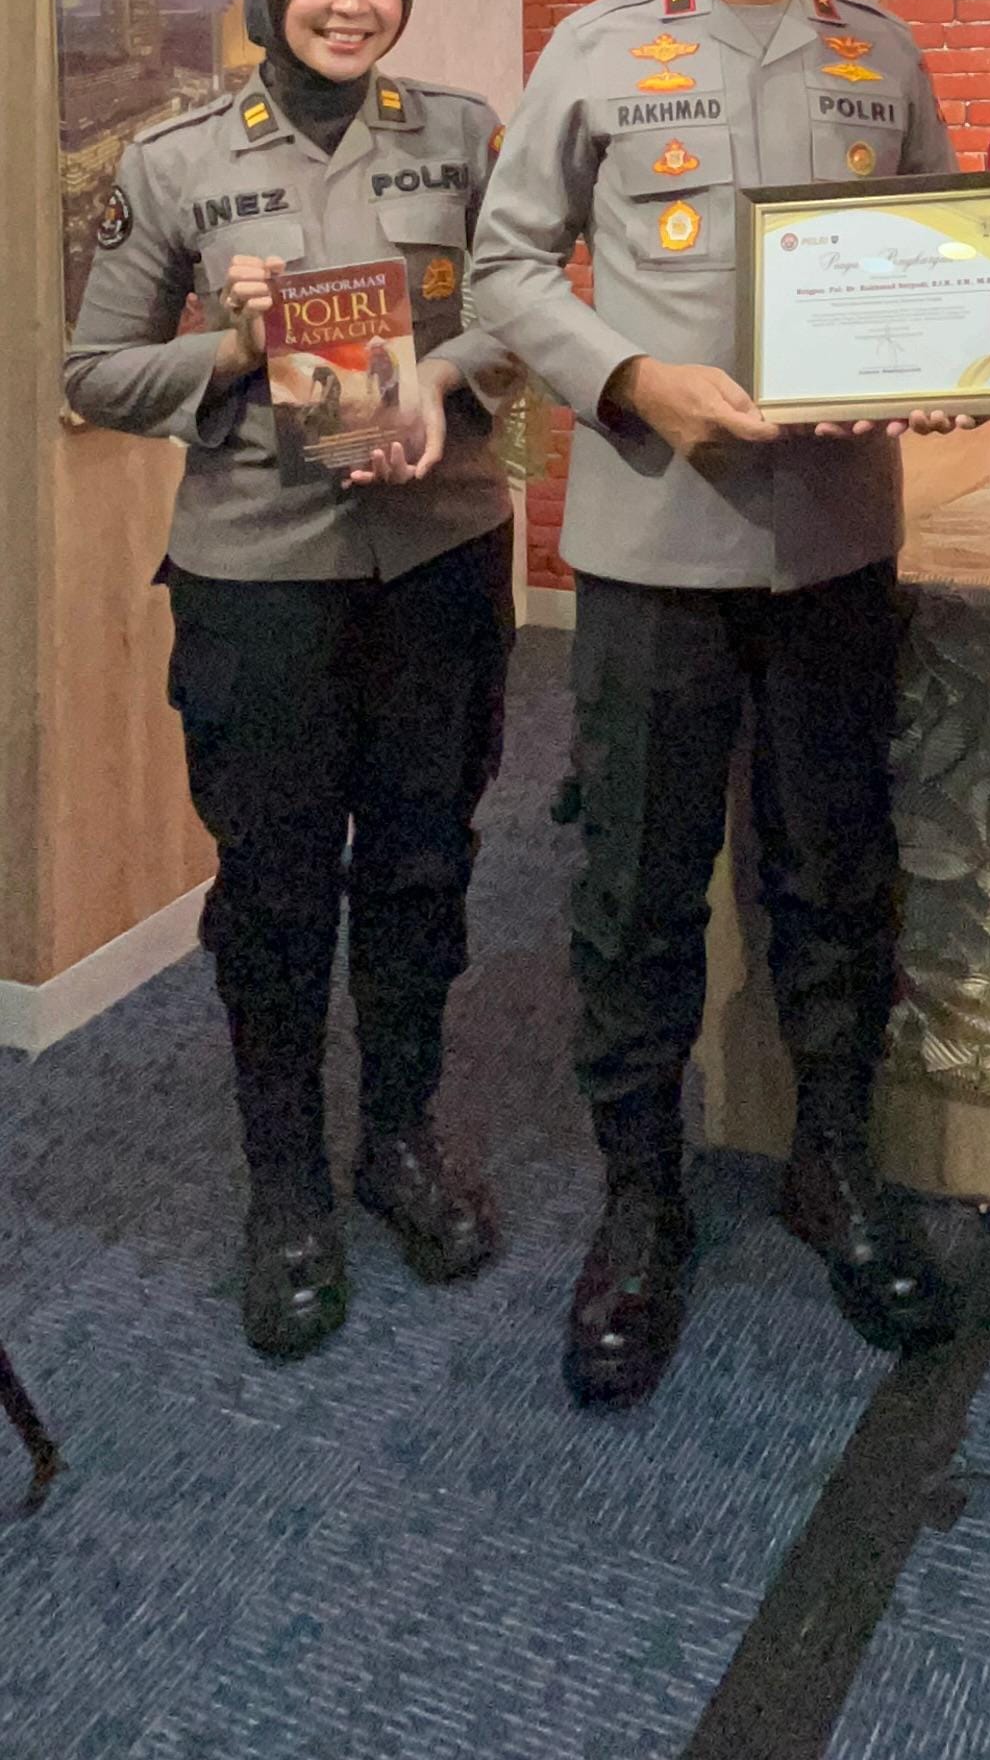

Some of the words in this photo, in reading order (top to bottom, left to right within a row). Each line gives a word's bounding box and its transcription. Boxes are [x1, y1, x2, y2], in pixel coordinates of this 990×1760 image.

[618, 99, 721, 127] RAKHMAD
[819, 96, 895, 122] POLRI
[371, 163, 468, 196] POLRI
[193, 189, 289, 233] INEZ
[281, 274, 386, 300] TRANSFORMASI
[284, 289, 391, 331] POLRI
[285, 329, 297, 344] &
[302, 326, 344, 345] ASTA
[349, 319, 391, 338] CITA
